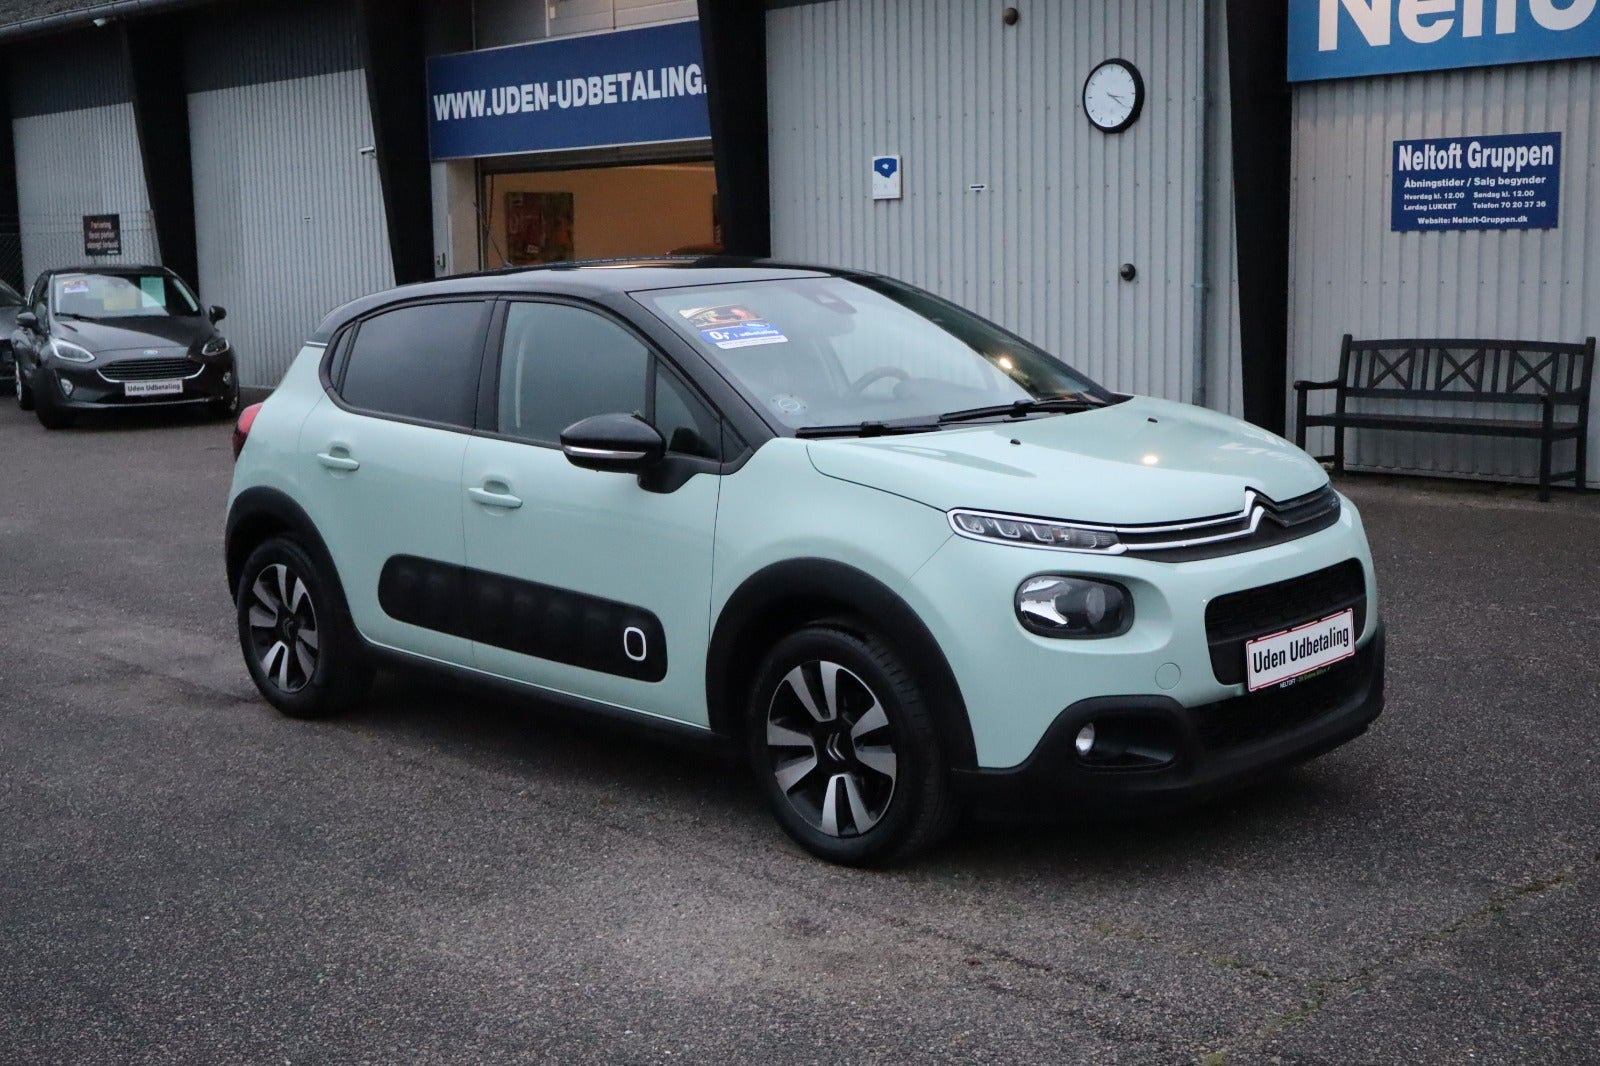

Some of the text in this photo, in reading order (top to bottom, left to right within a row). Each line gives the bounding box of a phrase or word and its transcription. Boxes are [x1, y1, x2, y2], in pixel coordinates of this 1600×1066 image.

[1399, 141, 1554, 173] Neltoft Gruppen
[1404, 177, 1465, 188] Åbningstider
[1474, 177, 1496, 188] Salg
[1498, 175, 1546, 186] begynder
[1404, 192, 1432, 201] Hverdag
[1418, 215, 1528, 225] Website: Neltoft-Gruppen.dk
[1253, 648, 1286, 674] Uden
[1290, 626, 1349, 662] Udbetaling
